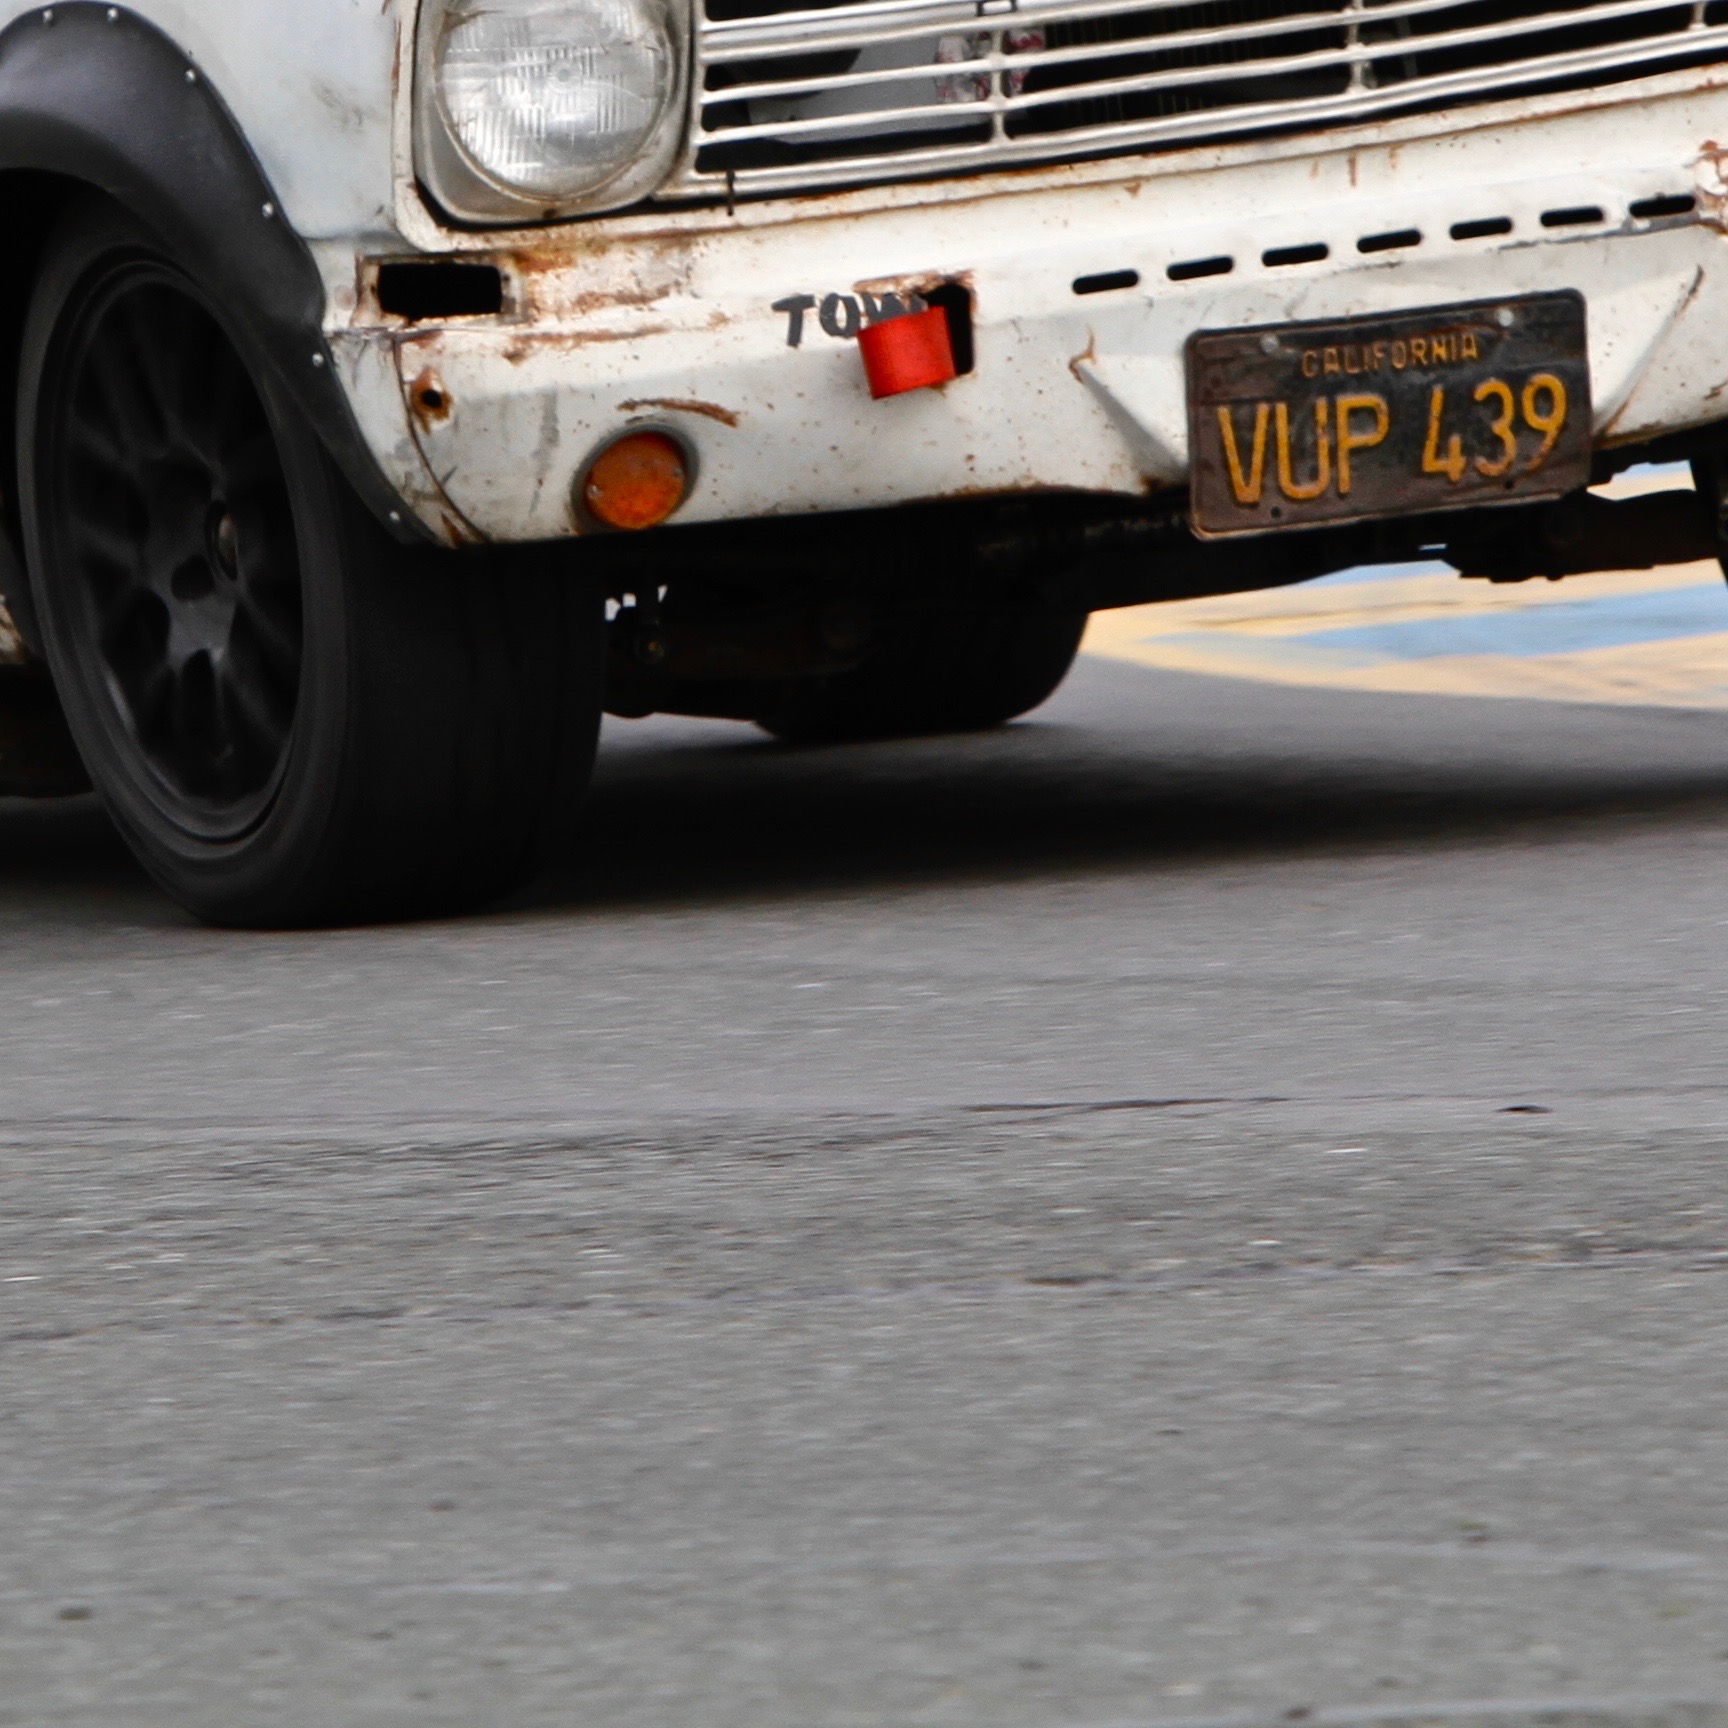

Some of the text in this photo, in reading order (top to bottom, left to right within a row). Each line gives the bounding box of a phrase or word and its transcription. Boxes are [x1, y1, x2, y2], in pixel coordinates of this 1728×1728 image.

[1301, 332, 1479, 379] CALIFORNIA
[1217, 371, 1568, 506] VUP 439
